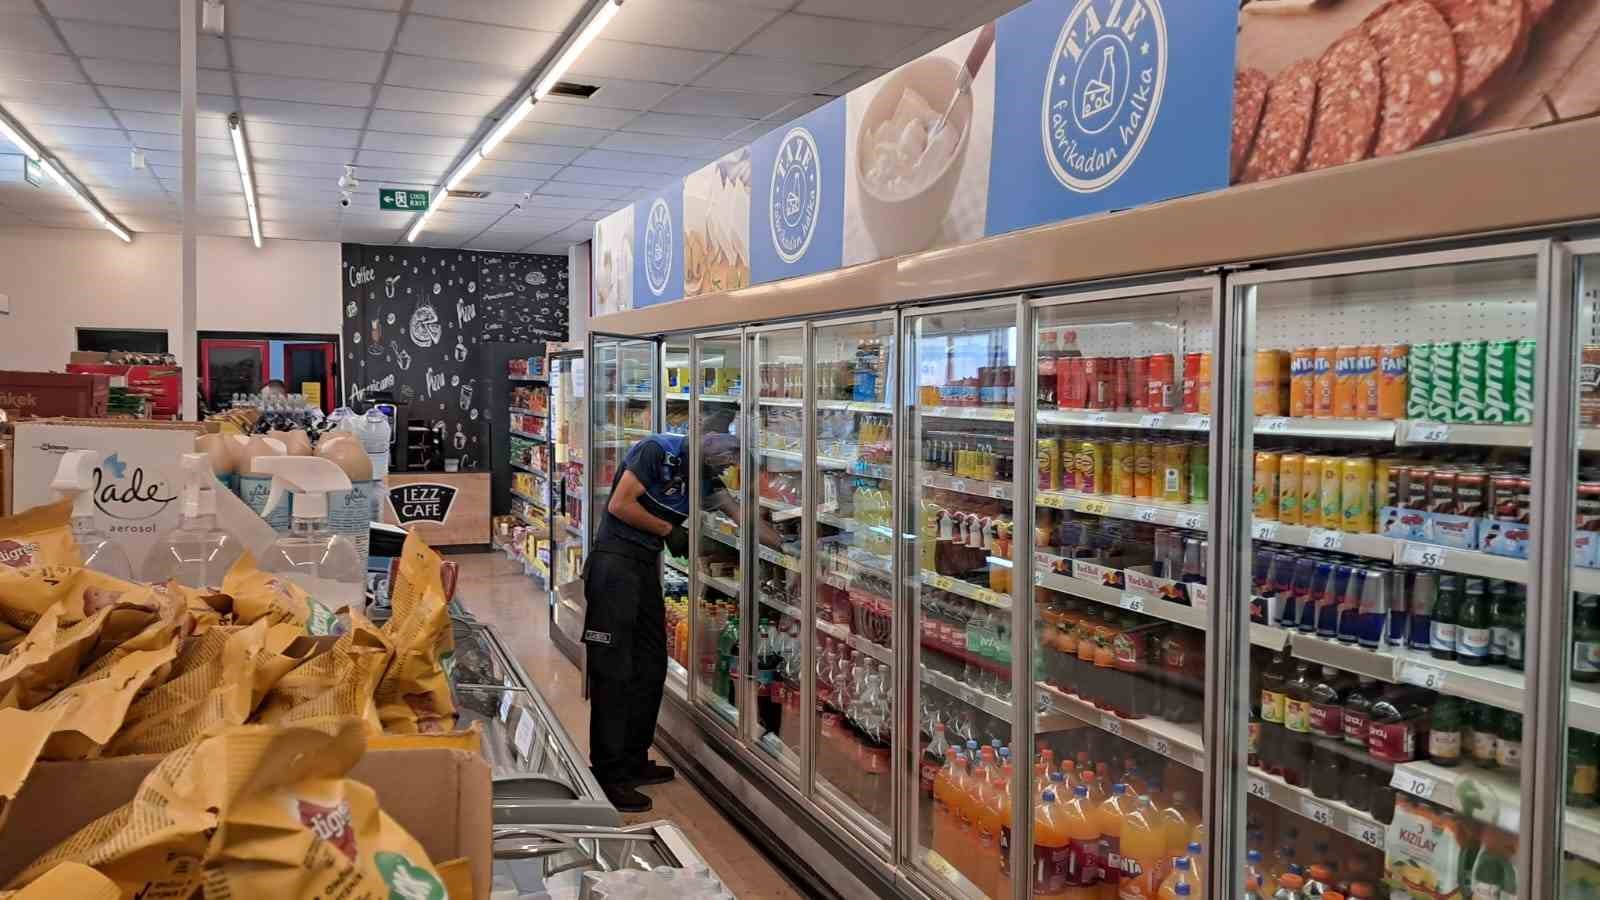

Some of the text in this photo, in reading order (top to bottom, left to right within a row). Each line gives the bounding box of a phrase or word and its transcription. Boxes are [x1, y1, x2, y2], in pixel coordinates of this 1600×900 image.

[1063, 0, 1147, 64] TAZE
[1052, 67, 1153, 173] fabrikadan halka
[349, 265, 376, 288] Coffee
[456, 298, 476, 329] Pizza
[1381, 355, 1408, 371] FAN
[93, 467, 178, 512] lade
[403, 488, 441, 503] LEZZ
[402, 503, 441, 517] CAFE
[110, 523, 157, 533] aerosol
[1259, 528, 1270, 538] 21
[1324, 536, 1335, 547] 21
[1421, 552, 1436, 566] 55
[1425, 674, 1435, 687] 8
[1251, 783, 1265, 796] 24
[1410, 780, 1426, 794] 10
[1313, 810, 1327, 823] 45
[1362, 830, 1377, 844] 45
